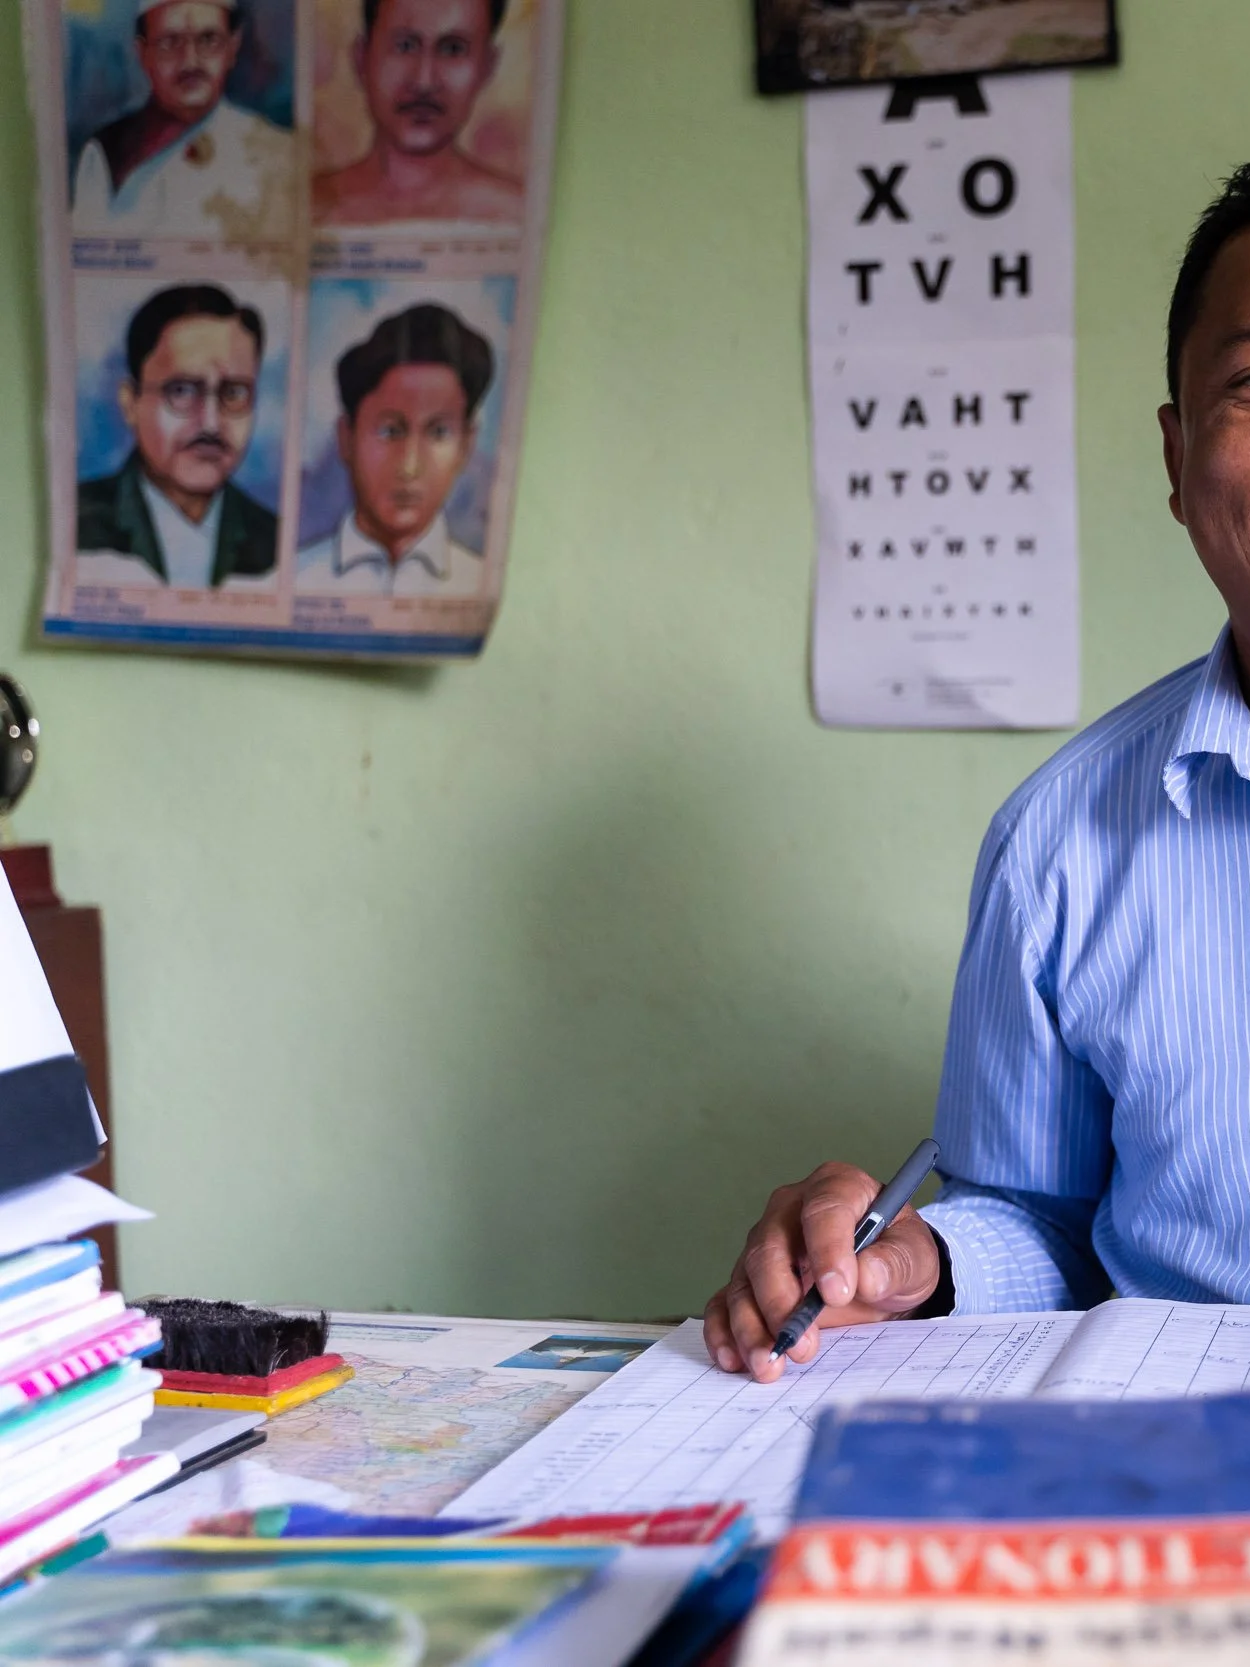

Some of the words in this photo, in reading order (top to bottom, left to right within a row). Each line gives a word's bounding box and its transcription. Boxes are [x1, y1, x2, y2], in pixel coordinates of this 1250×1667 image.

[858, 163, 909, 224] X
[959, 157, 1017, 218] O
[845, 261, 883, 305] T
[911, 257, 953, 302] V
[990, 252, 1031, 298] H
[848, 399, 878, 431] V
[899, 396, 928, 428] A
[952, 394, 983, 426] H
[1004, 391, 1031, 424] T
[848, 474, 872, 497] H
[888, 470, 908, 496] T
[924, 468, 952, 497] O
[965, 469, 990, 494] V
[1010, 468, 1031, 492] X
